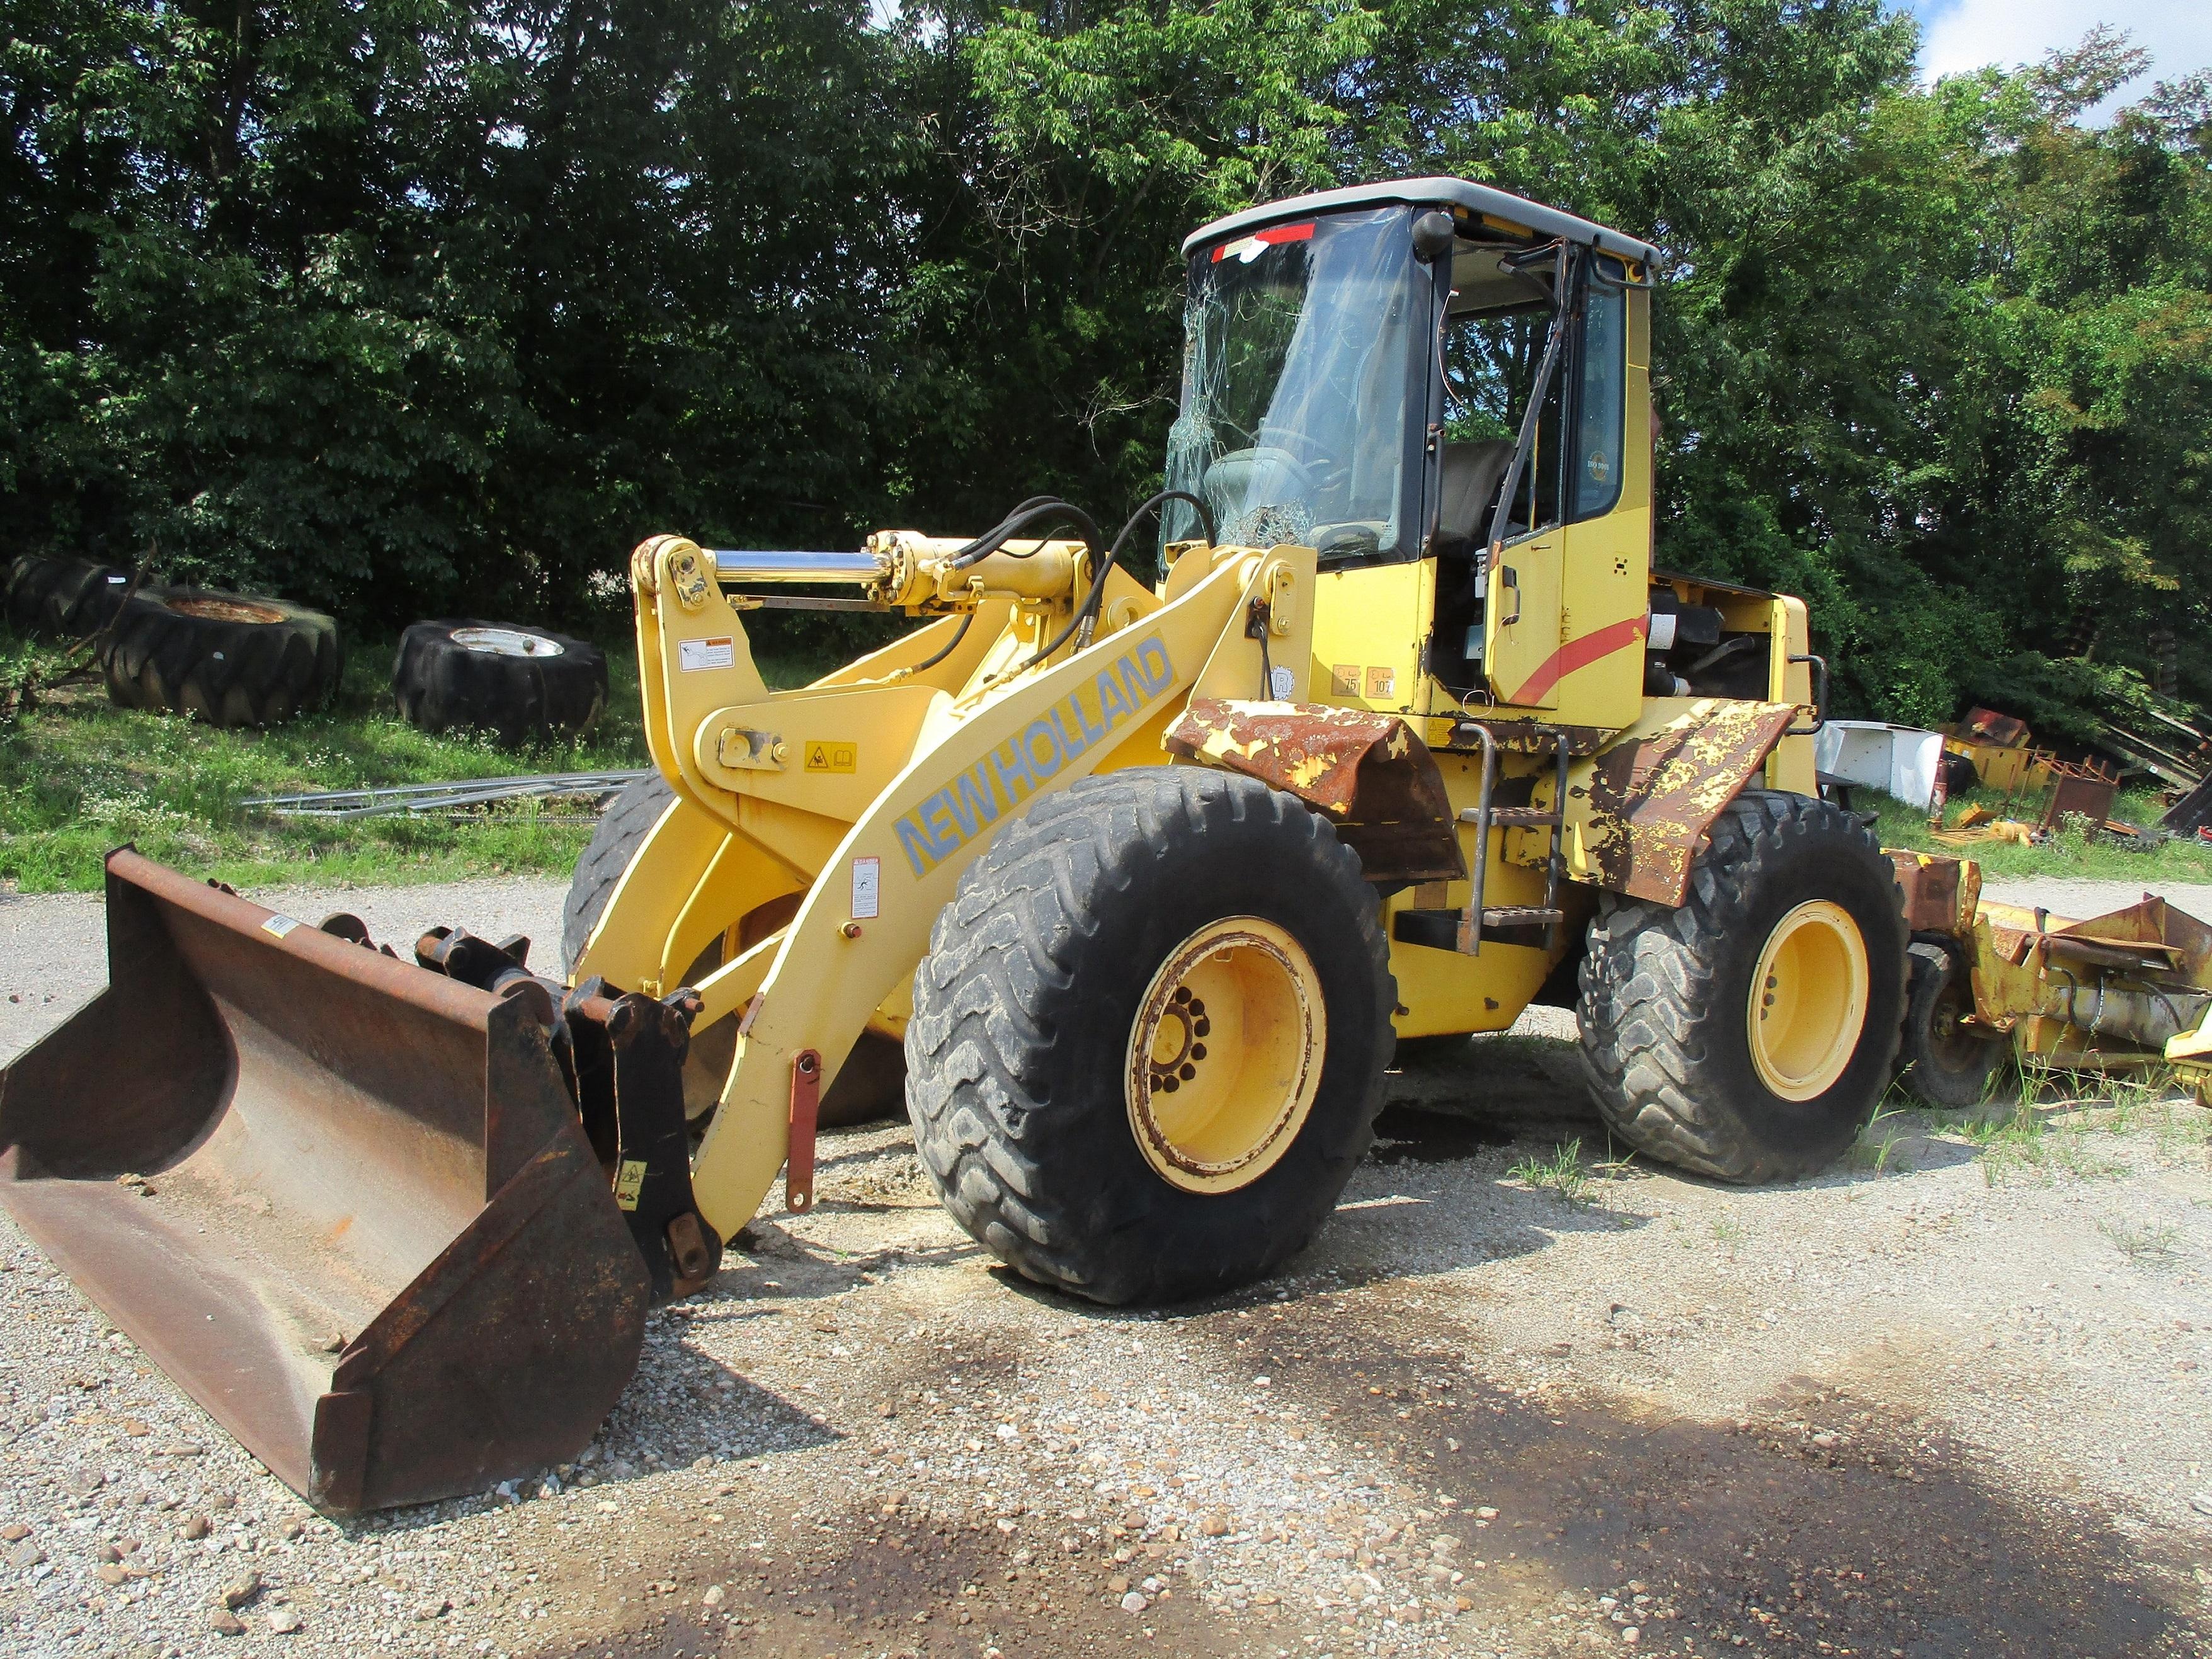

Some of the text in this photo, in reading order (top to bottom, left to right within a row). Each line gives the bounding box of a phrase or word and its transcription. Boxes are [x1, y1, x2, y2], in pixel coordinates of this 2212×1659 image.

[1275, 672, 1288, 693] R
[1345, 678, 1357, 690] 75
[1374, 680, 1391, 693] 107
[894, 636, 1174, 875] NEW HOLLAND
